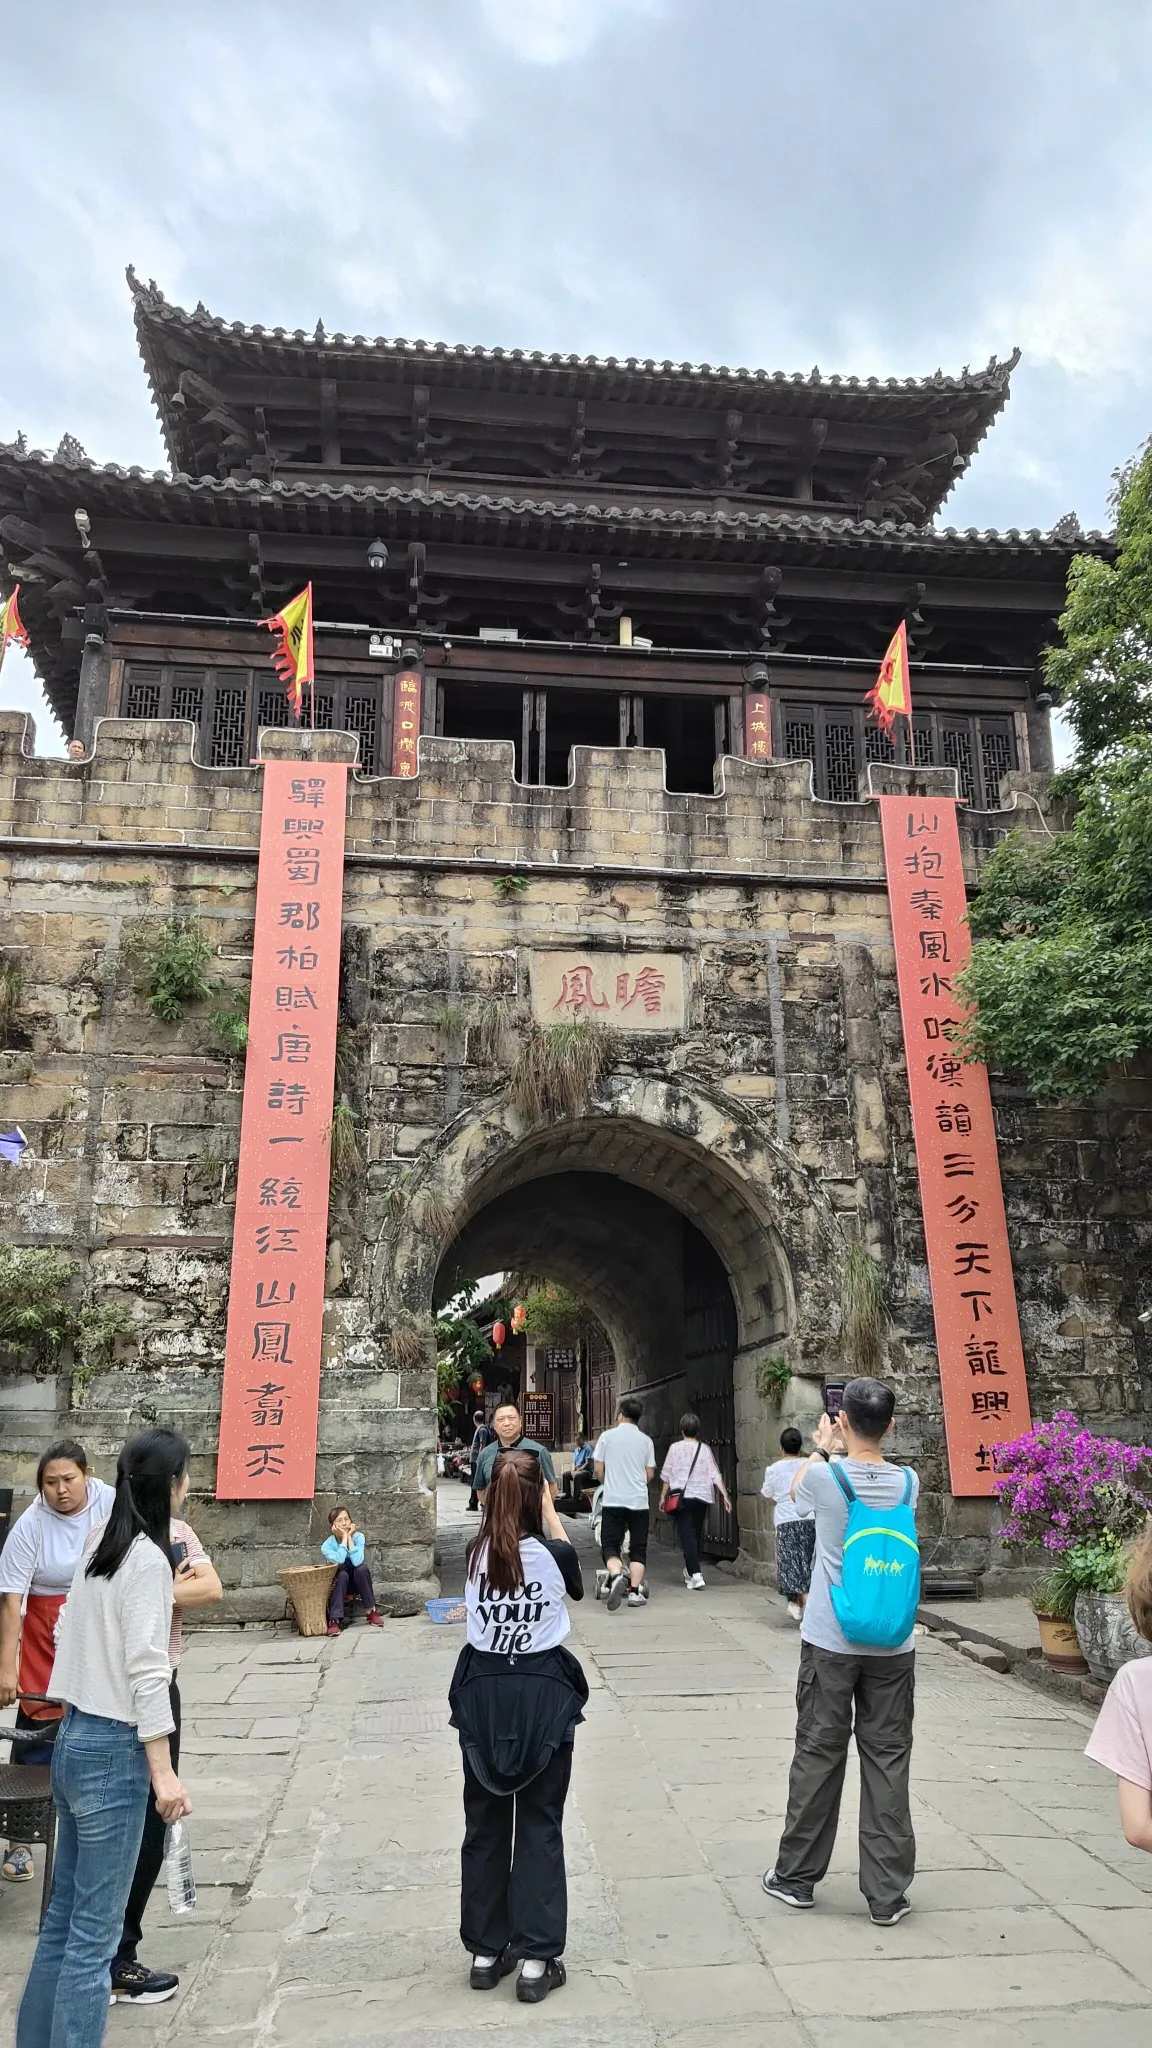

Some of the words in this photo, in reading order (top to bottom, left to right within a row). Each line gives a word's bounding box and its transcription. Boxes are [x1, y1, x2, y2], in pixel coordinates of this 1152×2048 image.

[751, 702, 767, 755] 上城樓
[475, 1601, 550, 1634] your
[489, 1624, 533, 1655] life
